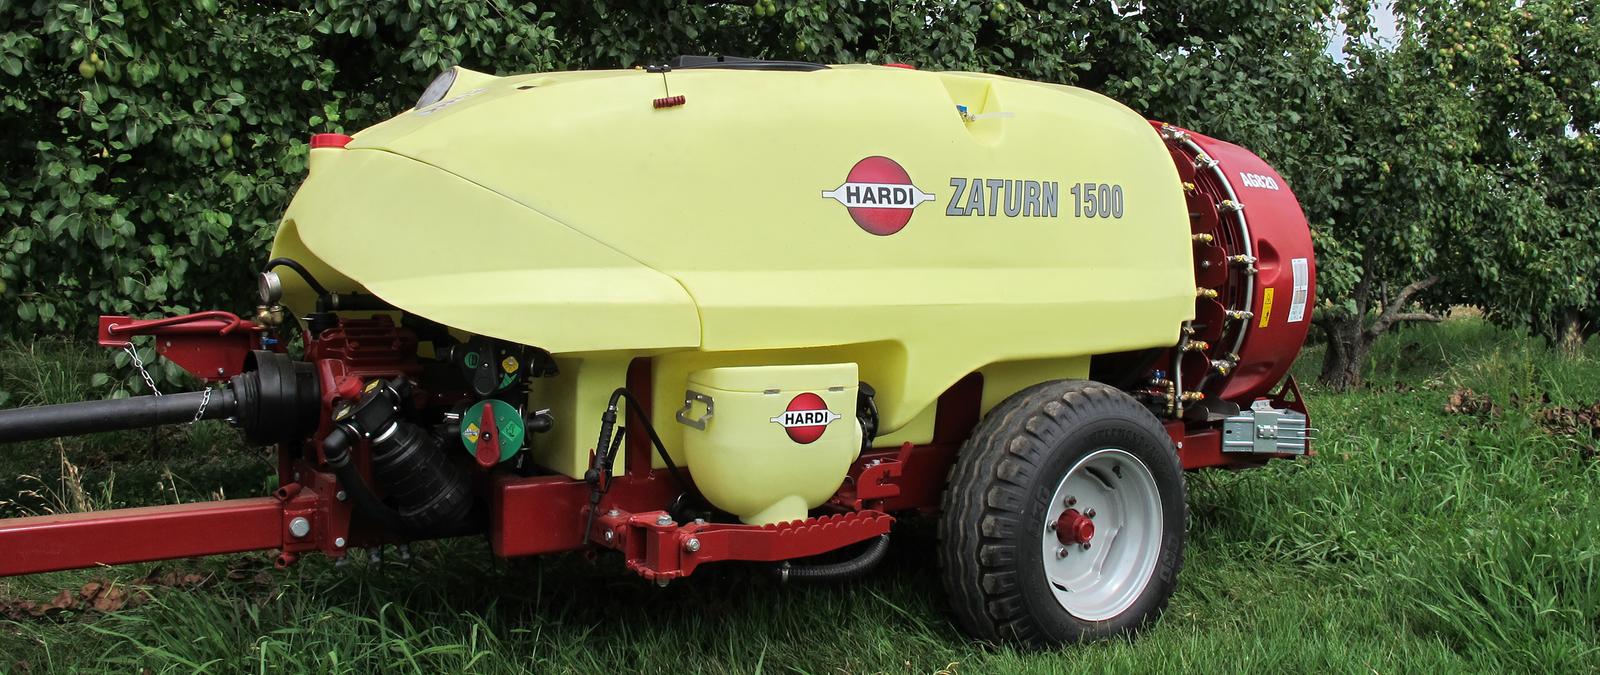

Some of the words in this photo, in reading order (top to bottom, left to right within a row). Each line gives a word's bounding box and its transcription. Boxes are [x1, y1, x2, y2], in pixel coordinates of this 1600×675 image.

[846, 185, 914, 206] HARDI
[945, 177, 1059, 218] ZATURN
[1070, 182, 1124, 219] 1500
[784, 411, 828, 426] HARDI
